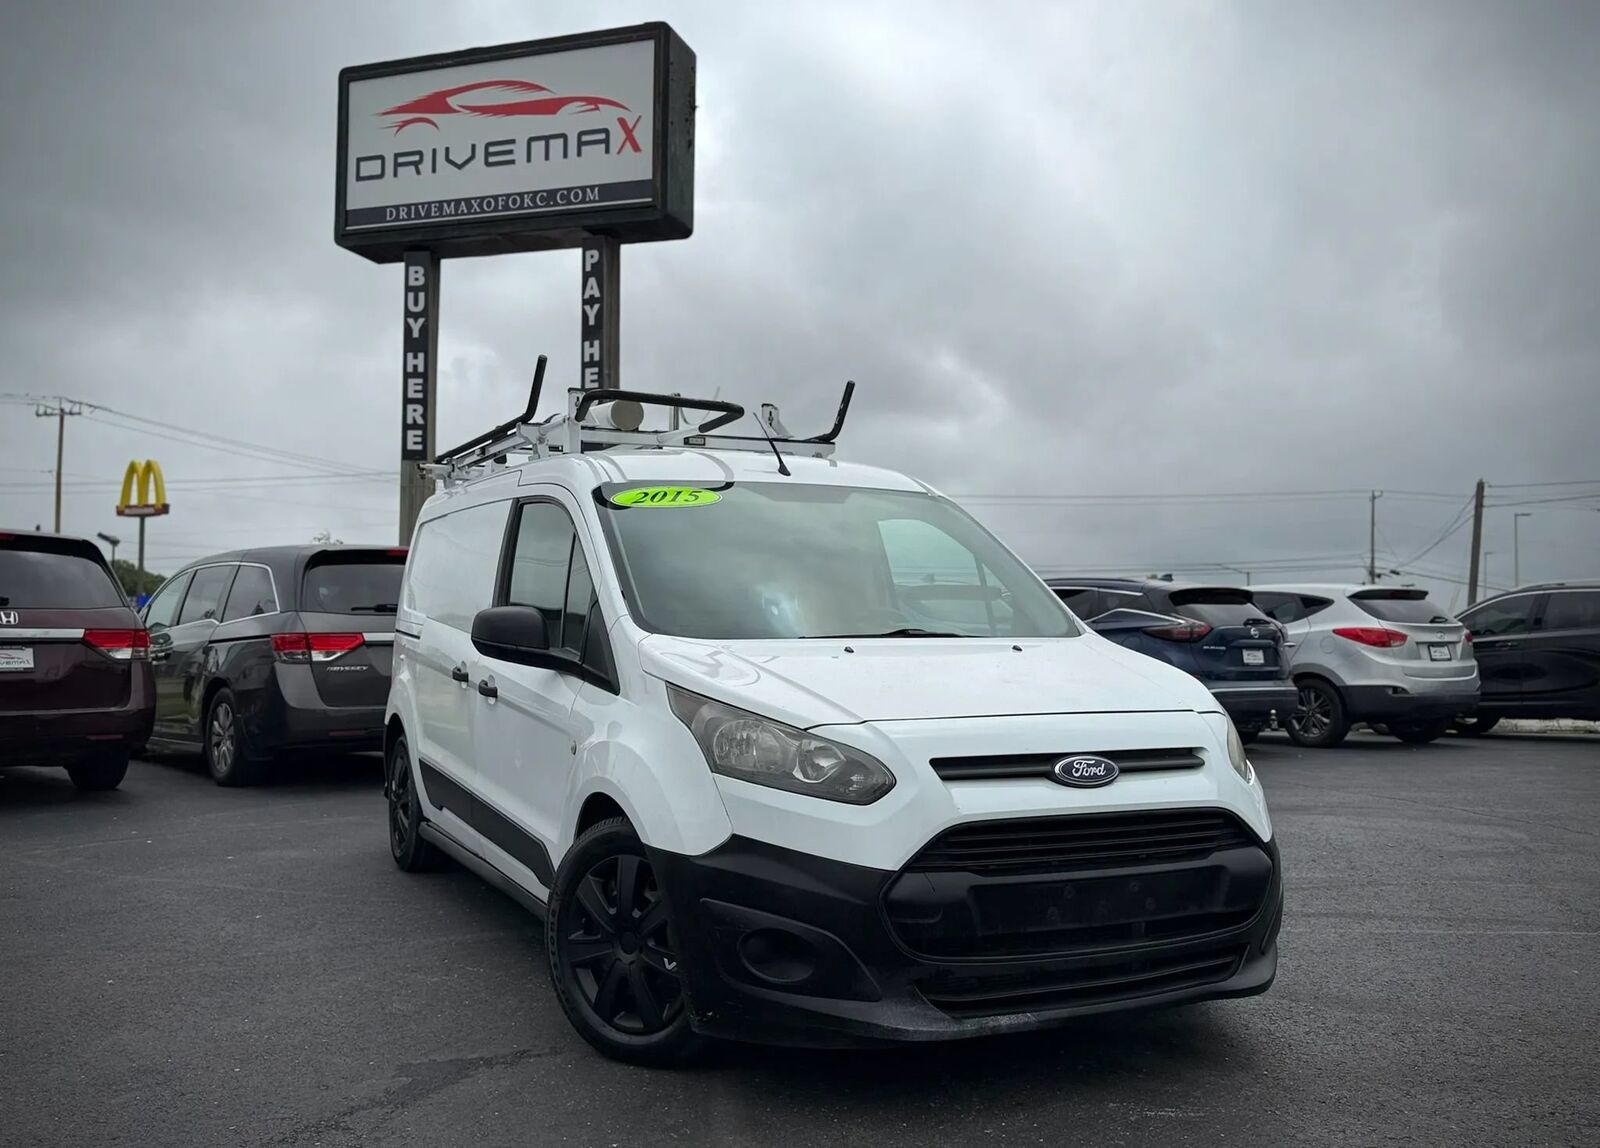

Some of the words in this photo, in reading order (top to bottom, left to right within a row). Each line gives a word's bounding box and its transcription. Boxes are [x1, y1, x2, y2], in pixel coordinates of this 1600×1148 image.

[355, 115, 642, 182] DRIVEMAX
[386, 187, 599, 221] DRIVEMAXOFOKC.COM
[406, 266, 425, 338] BUY
[583, 250, 600, 326] PAY
[406, 352, 425, 450] HERE
[583, 340, 600, 406] HE
[630, 490, 702, 504] 2015
[1072, 760, 1106, 777] Ford
